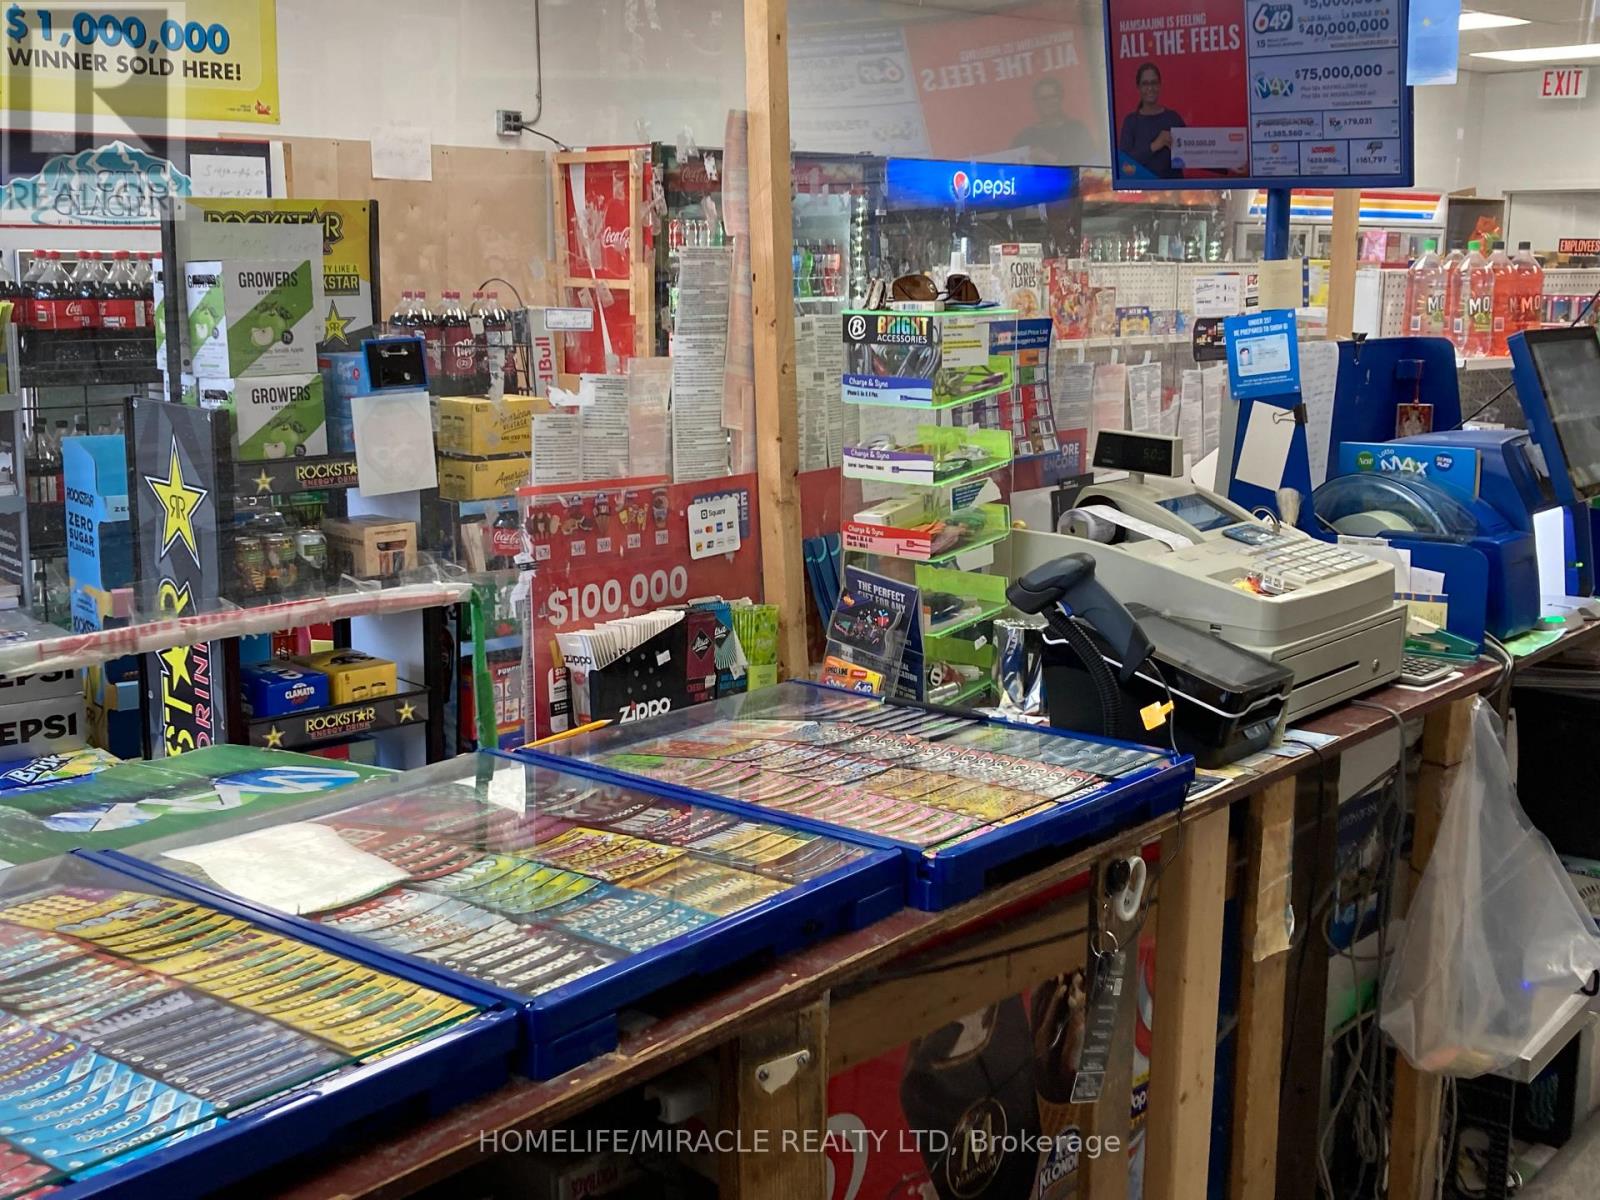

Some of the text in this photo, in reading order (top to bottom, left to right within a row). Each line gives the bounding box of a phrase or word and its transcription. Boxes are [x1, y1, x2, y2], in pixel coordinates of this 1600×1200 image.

[1176, 12, 1207, 27] FEELING
[1299, 18, 1389, 37] $40,000,000
[1119, 24, 1240, 59] ALL THE FEELS
[8, 47, 242, 81] WINNER SOLD HERE!
[1295, 64, 1383, 81] $75,000,000
[1542, 70, 1583, 97] EXIT
[53, 161, 167, 193] ARCTIC
[973, 177, 1015, 198] pepsi
[1560, 239, 1600, 253] EMPLOYEES
[334, 264, 350, 273] LIKE
[352, 264, 358, 273] A
[1010, 262, 1037, 276] CORN
[238, 271, 298, 288] GROWERS
[877, 316, 929, 336] BRIGHT
[876, 334, 928, 344] ACCESSORIES
[849, 377, 867, 387] Charge
[868, 379, 874, 387] &
[252, 385, 311, 405] GROWERS
[850, 448, 869, 458] Charge
[296, 461, 359, 480] ROCKSTA
[1380, 455, 1429, 477] MAX
[337, 476, 359, 485] DRIN
[68, 511, 94, 533] ZERO
[69, 531, 95, 548] SUGAR
[548, 565, 688, 628] $100,000
[857, 579, 905, 603] THE PERFECT
[285, 686, 315, 700] CLAMATO
[0, 712, 78, 746] EPSI
[305, 707, 376, 733] ROCKSTAR
[311, 727, 343, 739] ENERGY
